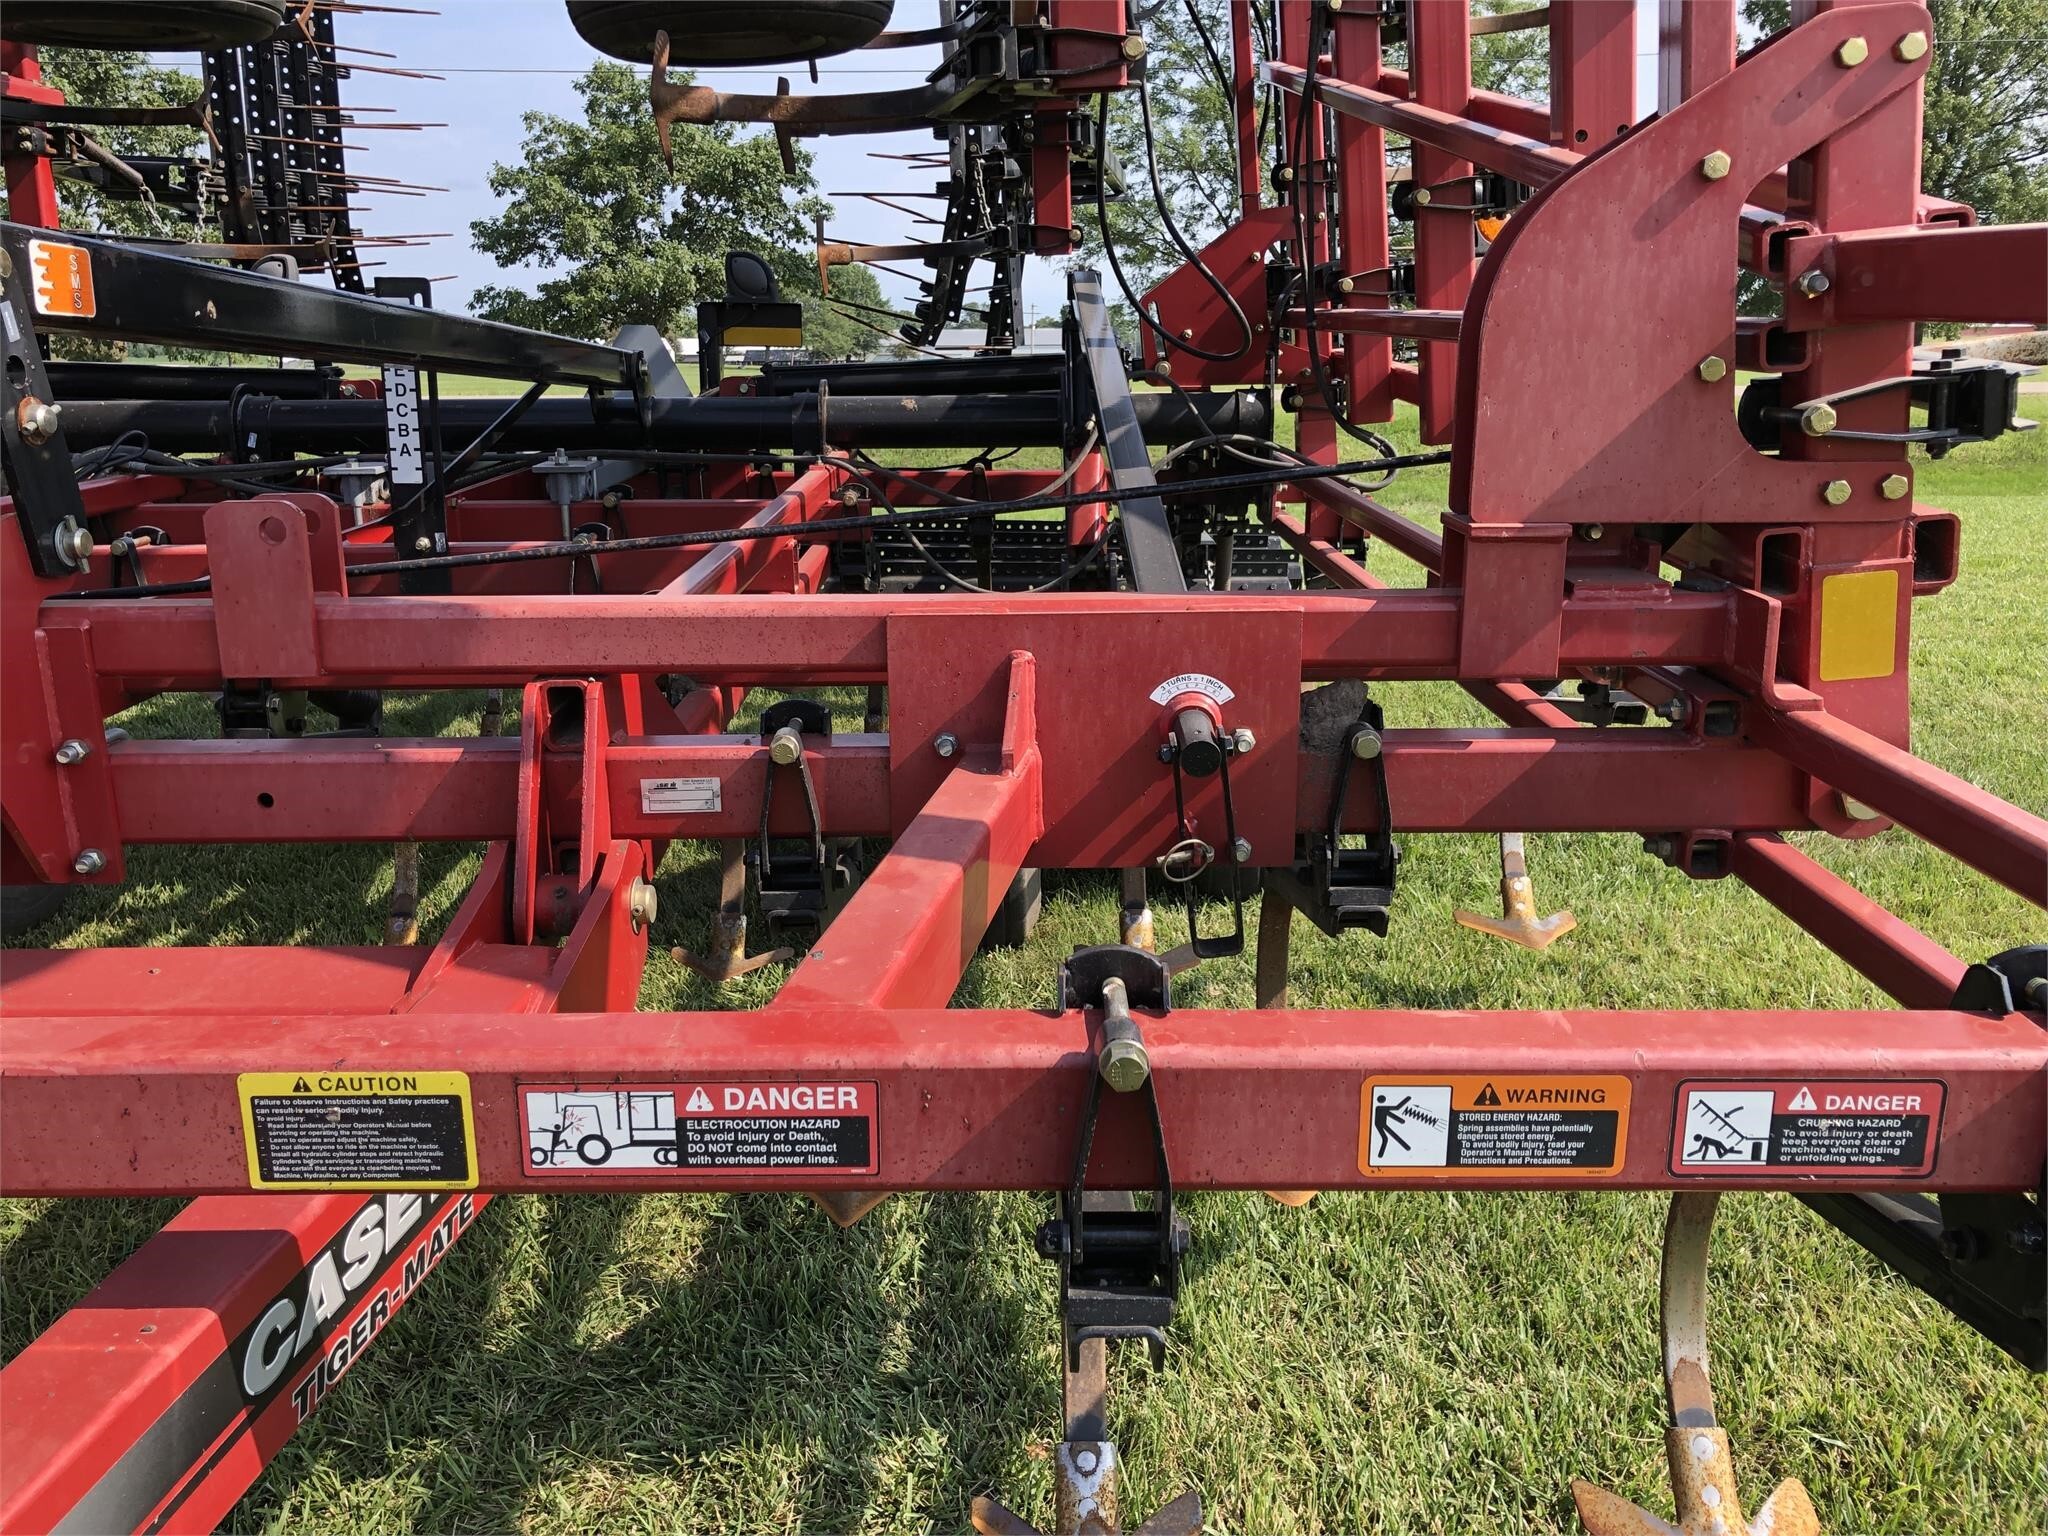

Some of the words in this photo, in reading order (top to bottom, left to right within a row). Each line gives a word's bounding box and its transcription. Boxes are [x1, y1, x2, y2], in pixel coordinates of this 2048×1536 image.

[395, 382, 407, 397] D
[396, 403, 408, 417] C
[398, 423, 410, 437] B
[399, 443, 411, 457] A
[318, 1077, 417, 1091] CAUTION
[724, 1087, 858, 1110] DANGER
[1506, 1088, 1606, 1104] WARNING
[388, 1098, 412, 1106] Safety
[414, 1098, 450, 1106] practices
[1826, 1096, 1921, 1110] DANGER
[1459, 1113, 1491, 1121] STORED
[1493, 1113, 1525, 1121] ENERGY
[1527, 1113, 1562, 1121] HAZARD:
[686, 1120, 787, 1129] ELECTROCUTION
[791, 1119, 840, 1129] HAZARD
[1798, 1119, 1854, 1127] CRUHNG
[1857, 1119, 1901, 1127] HAZARD
[1458, 1124, 1483, 1133] Spring
[1552, 1124, 1593, 1133] potentially
[687, 1132, 700, 1140] To
[704, 1132, 734, 1140] avoid
[789, 1131, 825, 1142] Death,
[1458, 1133, 1498, 1141] dangerous
[688, 1143, 705, 1152] DO
[708, 1143, 733, 1152] NOT
[770, 1143, 792, 1152] into
[795, 1142, 837, 1152] contact
[1496, 1141, 1519, 1149] bodily
[1548, 1140, 1565, 1148] read
[1782, 1138, 1808, 1147] keep
[1461, 1149, 1501, 1157] Operator's
[1862, 1146, 1900, 1156] folding
[688, 1155, 712, 1164] with
[714, 1155, 766, 1164] overhead
[770, 1156, 804, 1166] power
[808, 1154, 838, 1164] lines.
[1795, 1154, 1846, 1163] unfolding
[1850, 1155, 1885, 1163] wings.
[243, 1194, 422, 1396] CASE
[292, 1194, 475, 1424] TIGER-MATE
